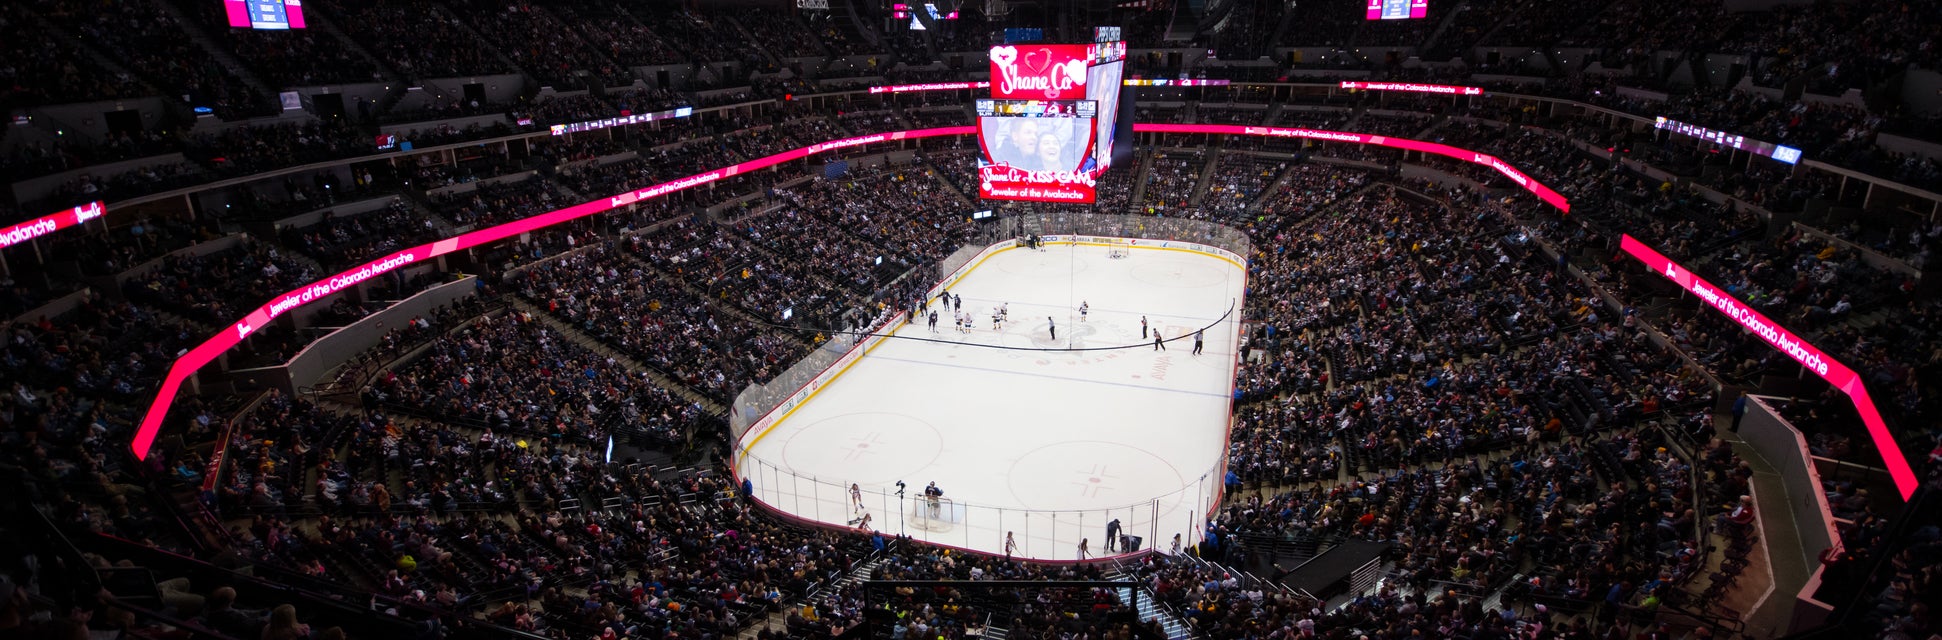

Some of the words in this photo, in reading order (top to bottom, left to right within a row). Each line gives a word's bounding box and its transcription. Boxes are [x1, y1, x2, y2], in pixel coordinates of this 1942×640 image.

[1001, 63, 1050, 94] Shane
[1428, 85, 1455, 93] Avalanche
[1066, 105, 1072, 113] 2
[1308, 130, 1331, 138] Colorado
[1332, 133, 1360, 141] Avalanche
[638, 188, 660, 199] Jeweler
[665, 183, 674, 192] the
[674, 177, 697, 190] Colorado
[696, 172, 719, 184] Avalanche
[983, 167, 1009, 183] Shane
[1028, 170, 1054, 183] KISS
[1055, 169, 1091, 184] CAM
[990, 187, 1018, 196] Jeweler
[1020, 188, 1028, 197] of
[1029, 188, 1041, 198] the
[1043, 189, 1084, 199] Avalanche
[0, 216, 56, 246] Avalanche
[269, 294, 300, 317] Jeweler
[302, 287, 313, 301] of
[313, 282, 330, 298] the
[330, 268, 371, 290] Colorado
[371, 251, 414, 275] Avalanche
[1692, 280, 1718, 305] Jeweler
[1718, 297, 1728, 310] of
[1727, 301, 1740, 318] the
[1739, 308, 1778, 343] Colorado
[1777, 333, 1828, 376] Avalanche
[1152, 355, 1174, 381] AVAYA
[753, 415, 774, 435] AVAYA
